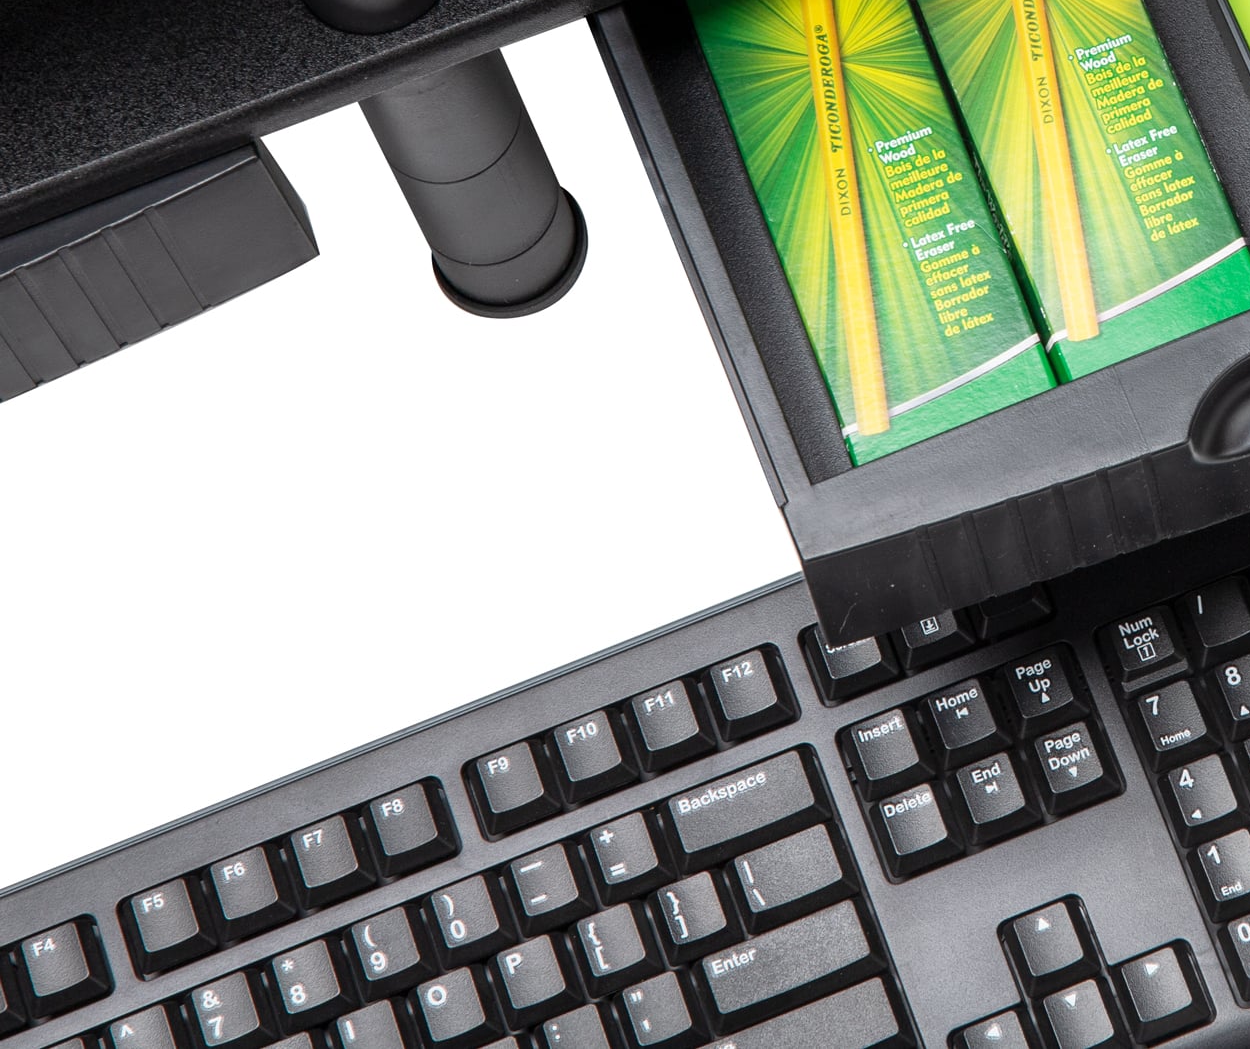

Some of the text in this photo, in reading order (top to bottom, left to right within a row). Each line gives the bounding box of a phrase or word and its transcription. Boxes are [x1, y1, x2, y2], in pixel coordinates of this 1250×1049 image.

[1075, 34, 1133, 60] Premium
[1079, 51, 1117, 72] Wood
[1085, 55, 1147, 85] Bois de la
[1091, 69, 1149, 97] meilleure
[1096, 78, 1164, 110] Madera de
[1036, 77, 1054, 124] DIXON
[1101, 98, 1151, 124] primera
[1106, 110, 1152, 134] calidad
[875, 126, 933, 153] Premium
[1113, 125, 1178, 156] Latex Free
[879, 144, 916, 164] Wood
[884, 148, 946, 178] Bois de la
[1118, 146, 1158, 168] Eraser
[889, 163, 949, 190] meilleure
[1124, 156, 1172, 179] Gomme
[835, 168, 851, 216] DIXON
[895, 171, 963, 202] Madera de
[1130, 169, 1173, 192] effacer
[1134, 175, 1195, 204] sans latex
[900, 191, 949, 218] primera
[1138, 190, 1194, 217] Borrador
[904, 203, 951, 228] calidad
[1144, 212, 1173, 229] libre
[910, 219, 975, 249] Latex Free
[1150, 229, 1166, 242] de
[915, 241, 955, 261] Eraser
[920, 250, 969, 273] Gomme
[925, 263, 969, 286] effacer
[930, 270, 991, 299] sans latex
[934, 285, 989, 311] Borrador
[938, 307, 968, 324] libre
[944, 324, 960, 337] de
[1117, 614, 1153, 637] Num
[1122, 626, 1160, 650] Lock
[722, 662, 753, 681] F12
[1015, 658, 1053, 681] Page
[1225, 666, 1242, 686] 8
[1028, 676, 1052, 696] Up
[644, 692, 674, 711] F11
[935, 687, 979, 712] Home
[1145, 695, 1161, 717] 7
[567, 723, 597, 743] F10
[857, 716, 904, 743] Insert
[1159, 728, 1191, 746] Home
[1043, 731, 1081, 753] Page
[487, 757, 509, 774] F9
[1048, 746, 1090, 771] Down
[971, 762, 1001, 784] End
[1178, 769, 1195, 789] 4
[677, 770, 767, 815] Backspace
[381, 799, 404, 816] F8
[883, 791, 932, 818] Delete
[303, 830, 323, 847] F7
[1206, 845, 1221, 864] 1
[223, 862, 245, 880] F6
[1220, 881, 1243, 897] End
[142, 894, 165, 912] F5
[449, 919, 466, 941] 0
[33, 939, 55, 956] F4
[370, 952, 387, 972] 9
[505, 954, 523, 974] P
[710, 948, 757, 975] Enter
[289, 985, 306, 1005] 8
[207, 1016, 224, 1039] 7
